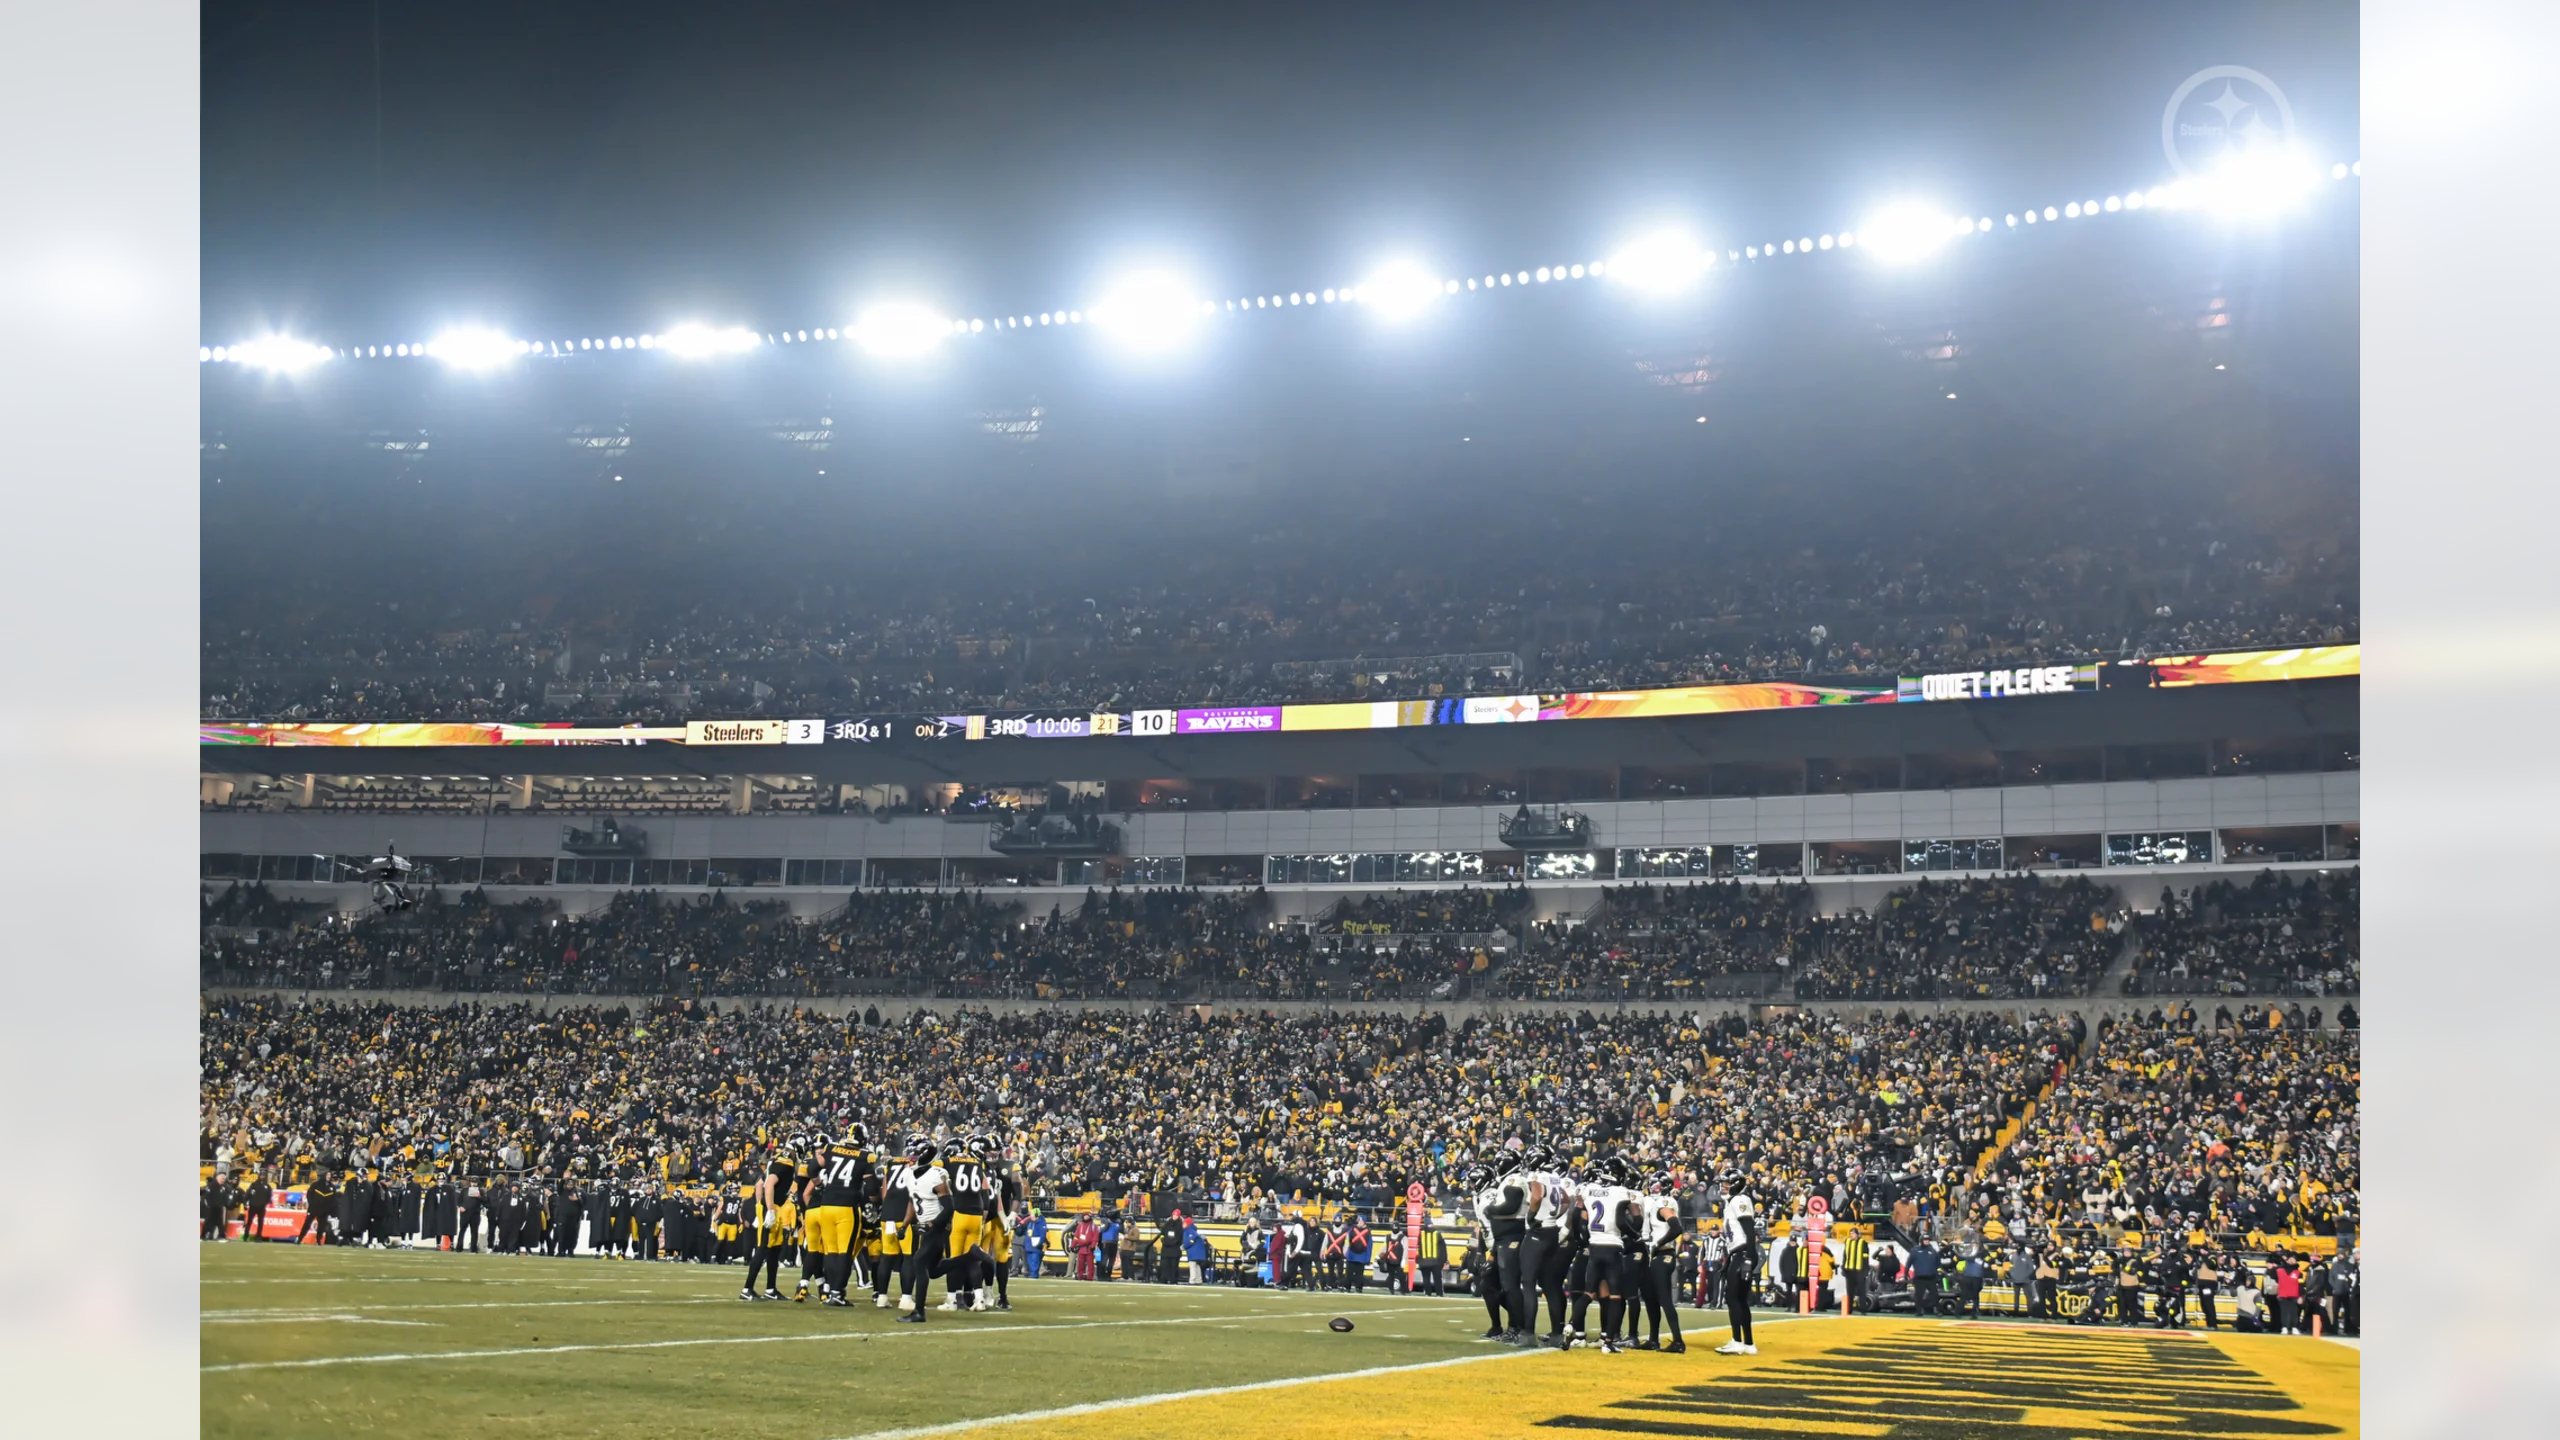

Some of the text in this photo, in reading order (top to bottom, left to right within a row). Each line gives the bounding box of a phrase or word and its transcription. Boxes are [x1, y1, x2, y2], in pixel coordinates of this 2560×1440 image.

[1922, 665, 2074, 701] QUIET PLEASE
[915, 721, 948, 737] ON 2
[990, 717, 1082, 735] 3RD 10:06
[1097, 718, 1112, 730] 21
[1140, 714, 1163, 730] 10
[1186, 715, 1273, 731] RAVENS
[703, 723, 764, 741] Steelers
[801, 724, 811, 739] 3
[833, 722, 892, 739] 3RD & 1
[831, 1145, 861, 1157] ANDERSON
[827, 1156, 856, 1187] 74
[955, 1164, 981, 1192] 66
[610, 1196, 621, 1207] 97
[1588, 1190, 1610, 1198] WIGGINS
[726, 1202, 738, 1215] 88
[1591, 1200, 1605, 1233] 2
